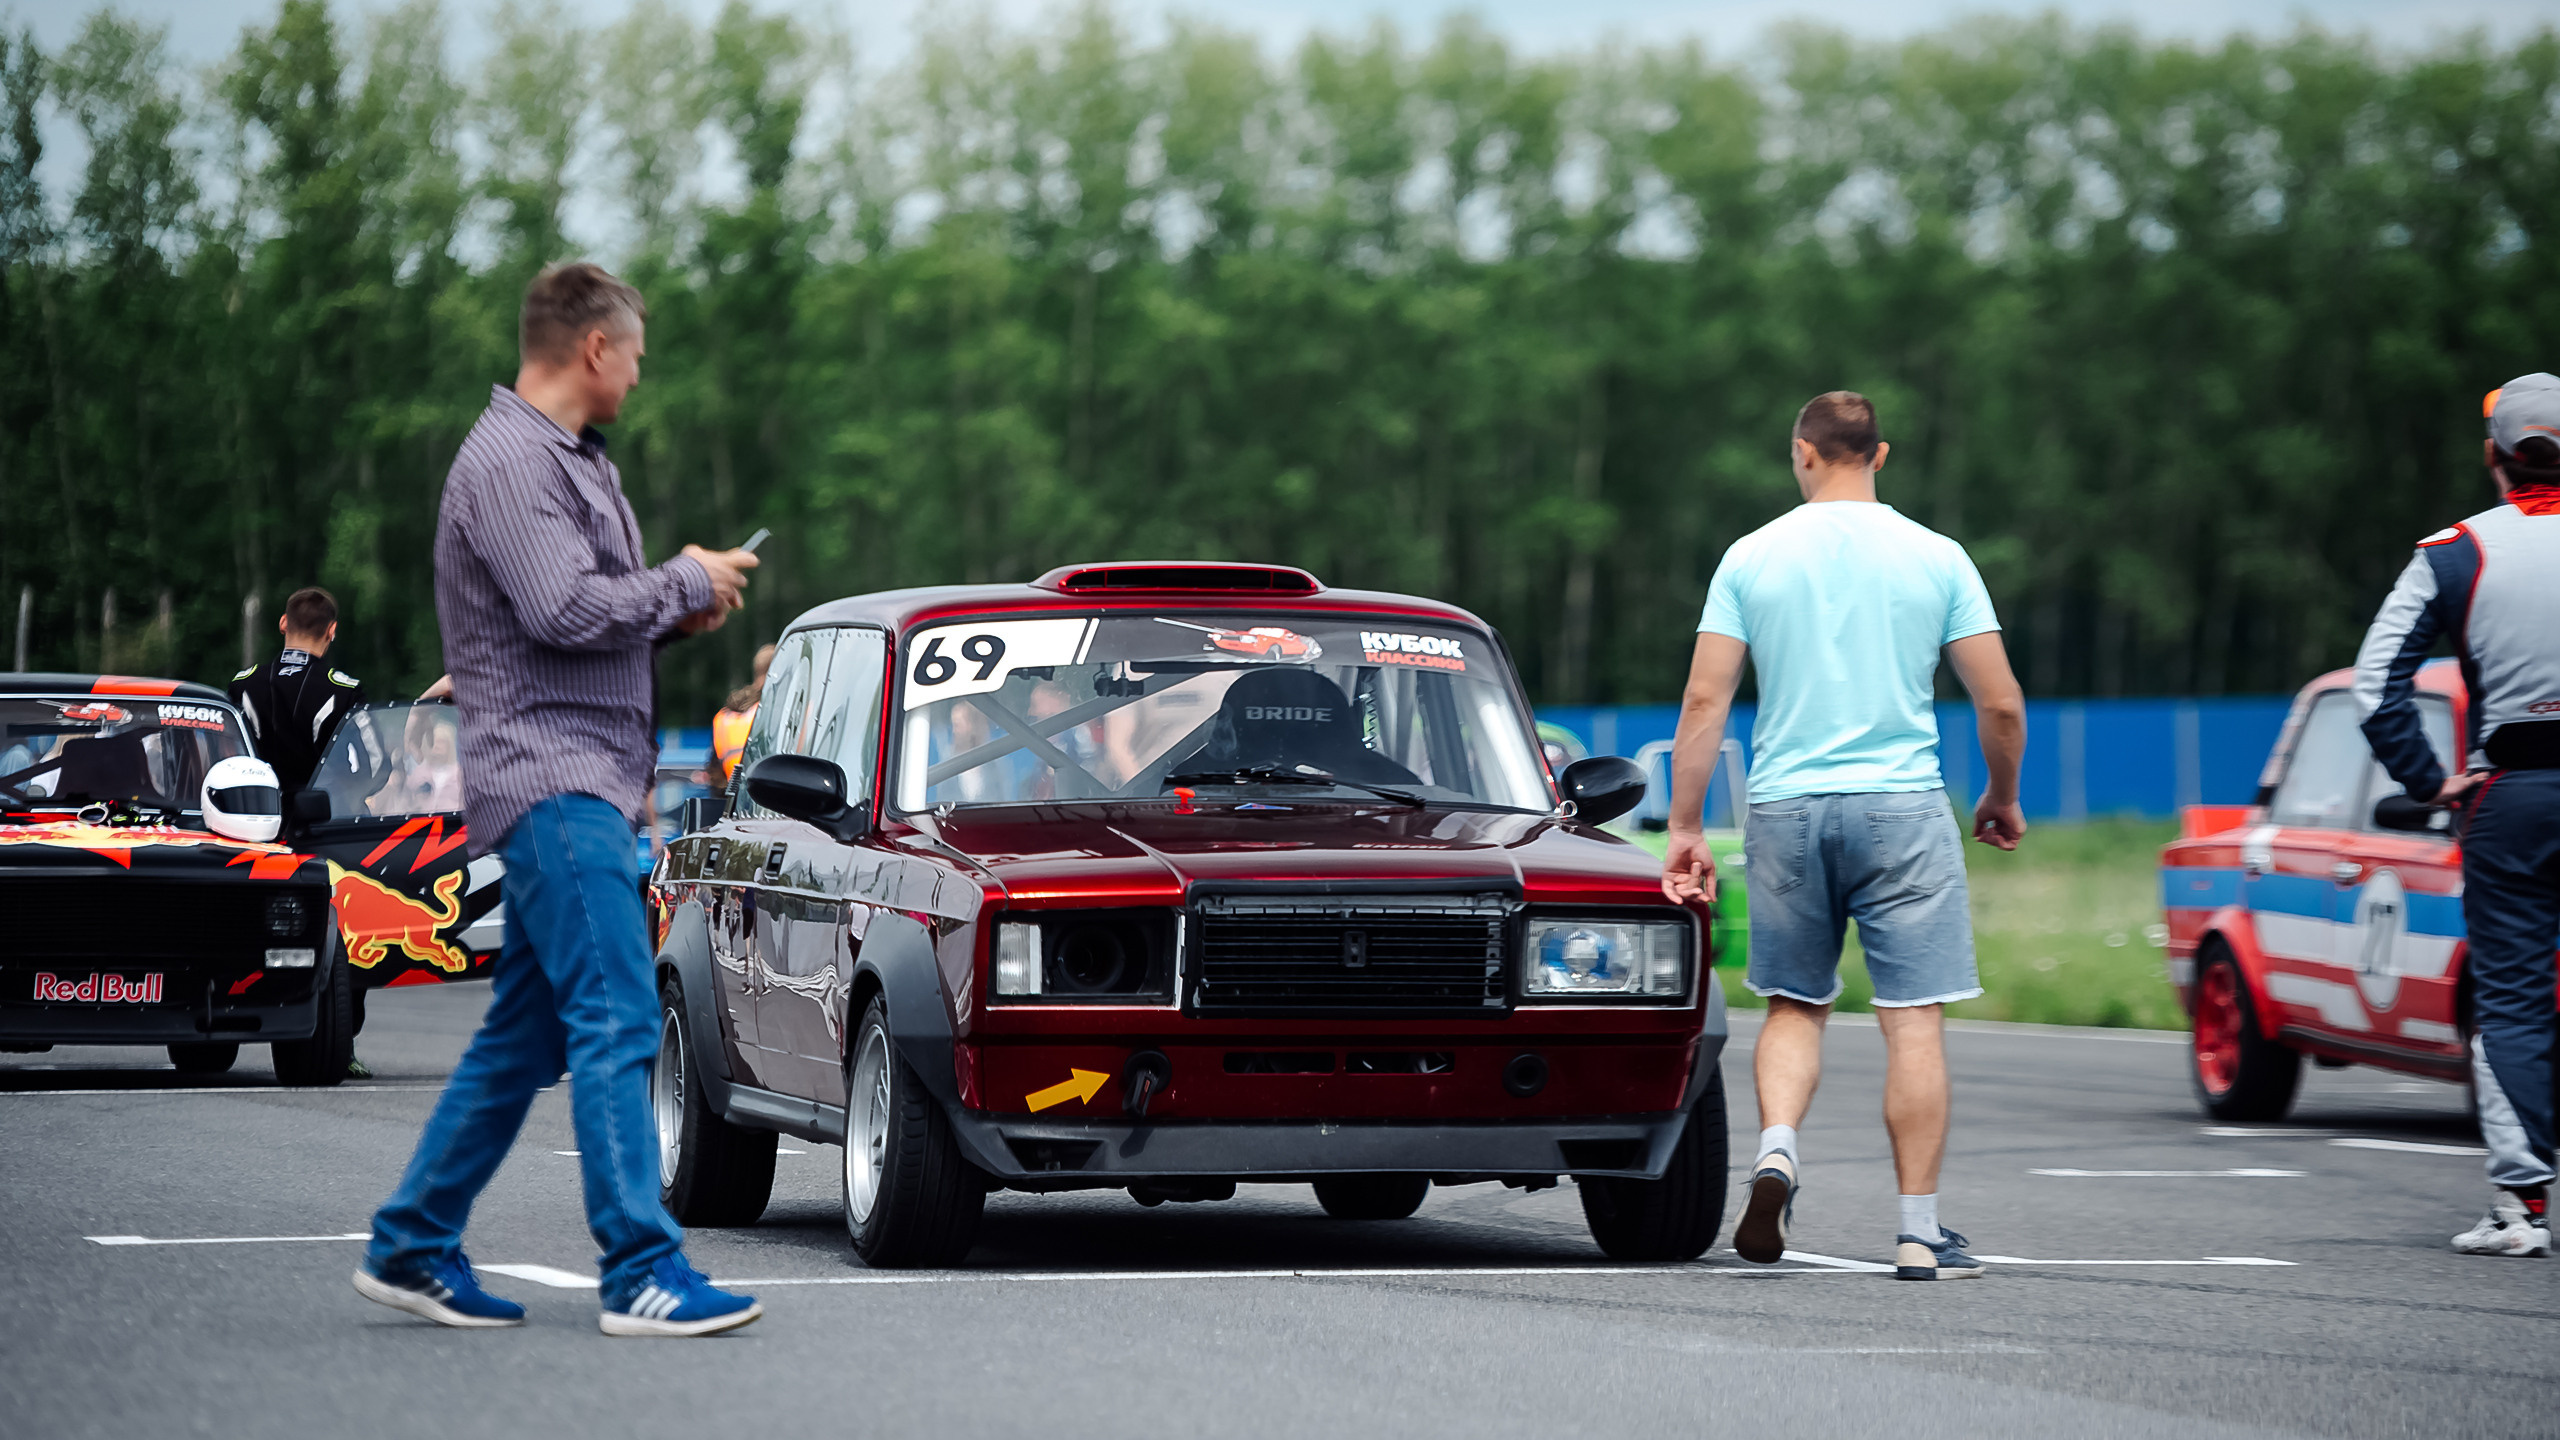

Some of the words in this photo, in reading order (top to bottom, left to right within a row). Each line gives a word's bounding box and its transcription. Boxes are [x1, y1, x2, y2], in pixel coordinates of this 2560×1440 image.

[1360, 631, 1465, 658] КУБОК
[913, 634, 1006, 686] 69
[1365, 651, 1466, 671] КЛАССИКИ
[158, 704, 224, 724] КУБОК
[1244, 706, 1334, 722] BRIDE
[33, 972, 99, 1001] Red
[100, 972, 163, 1003] Bull
